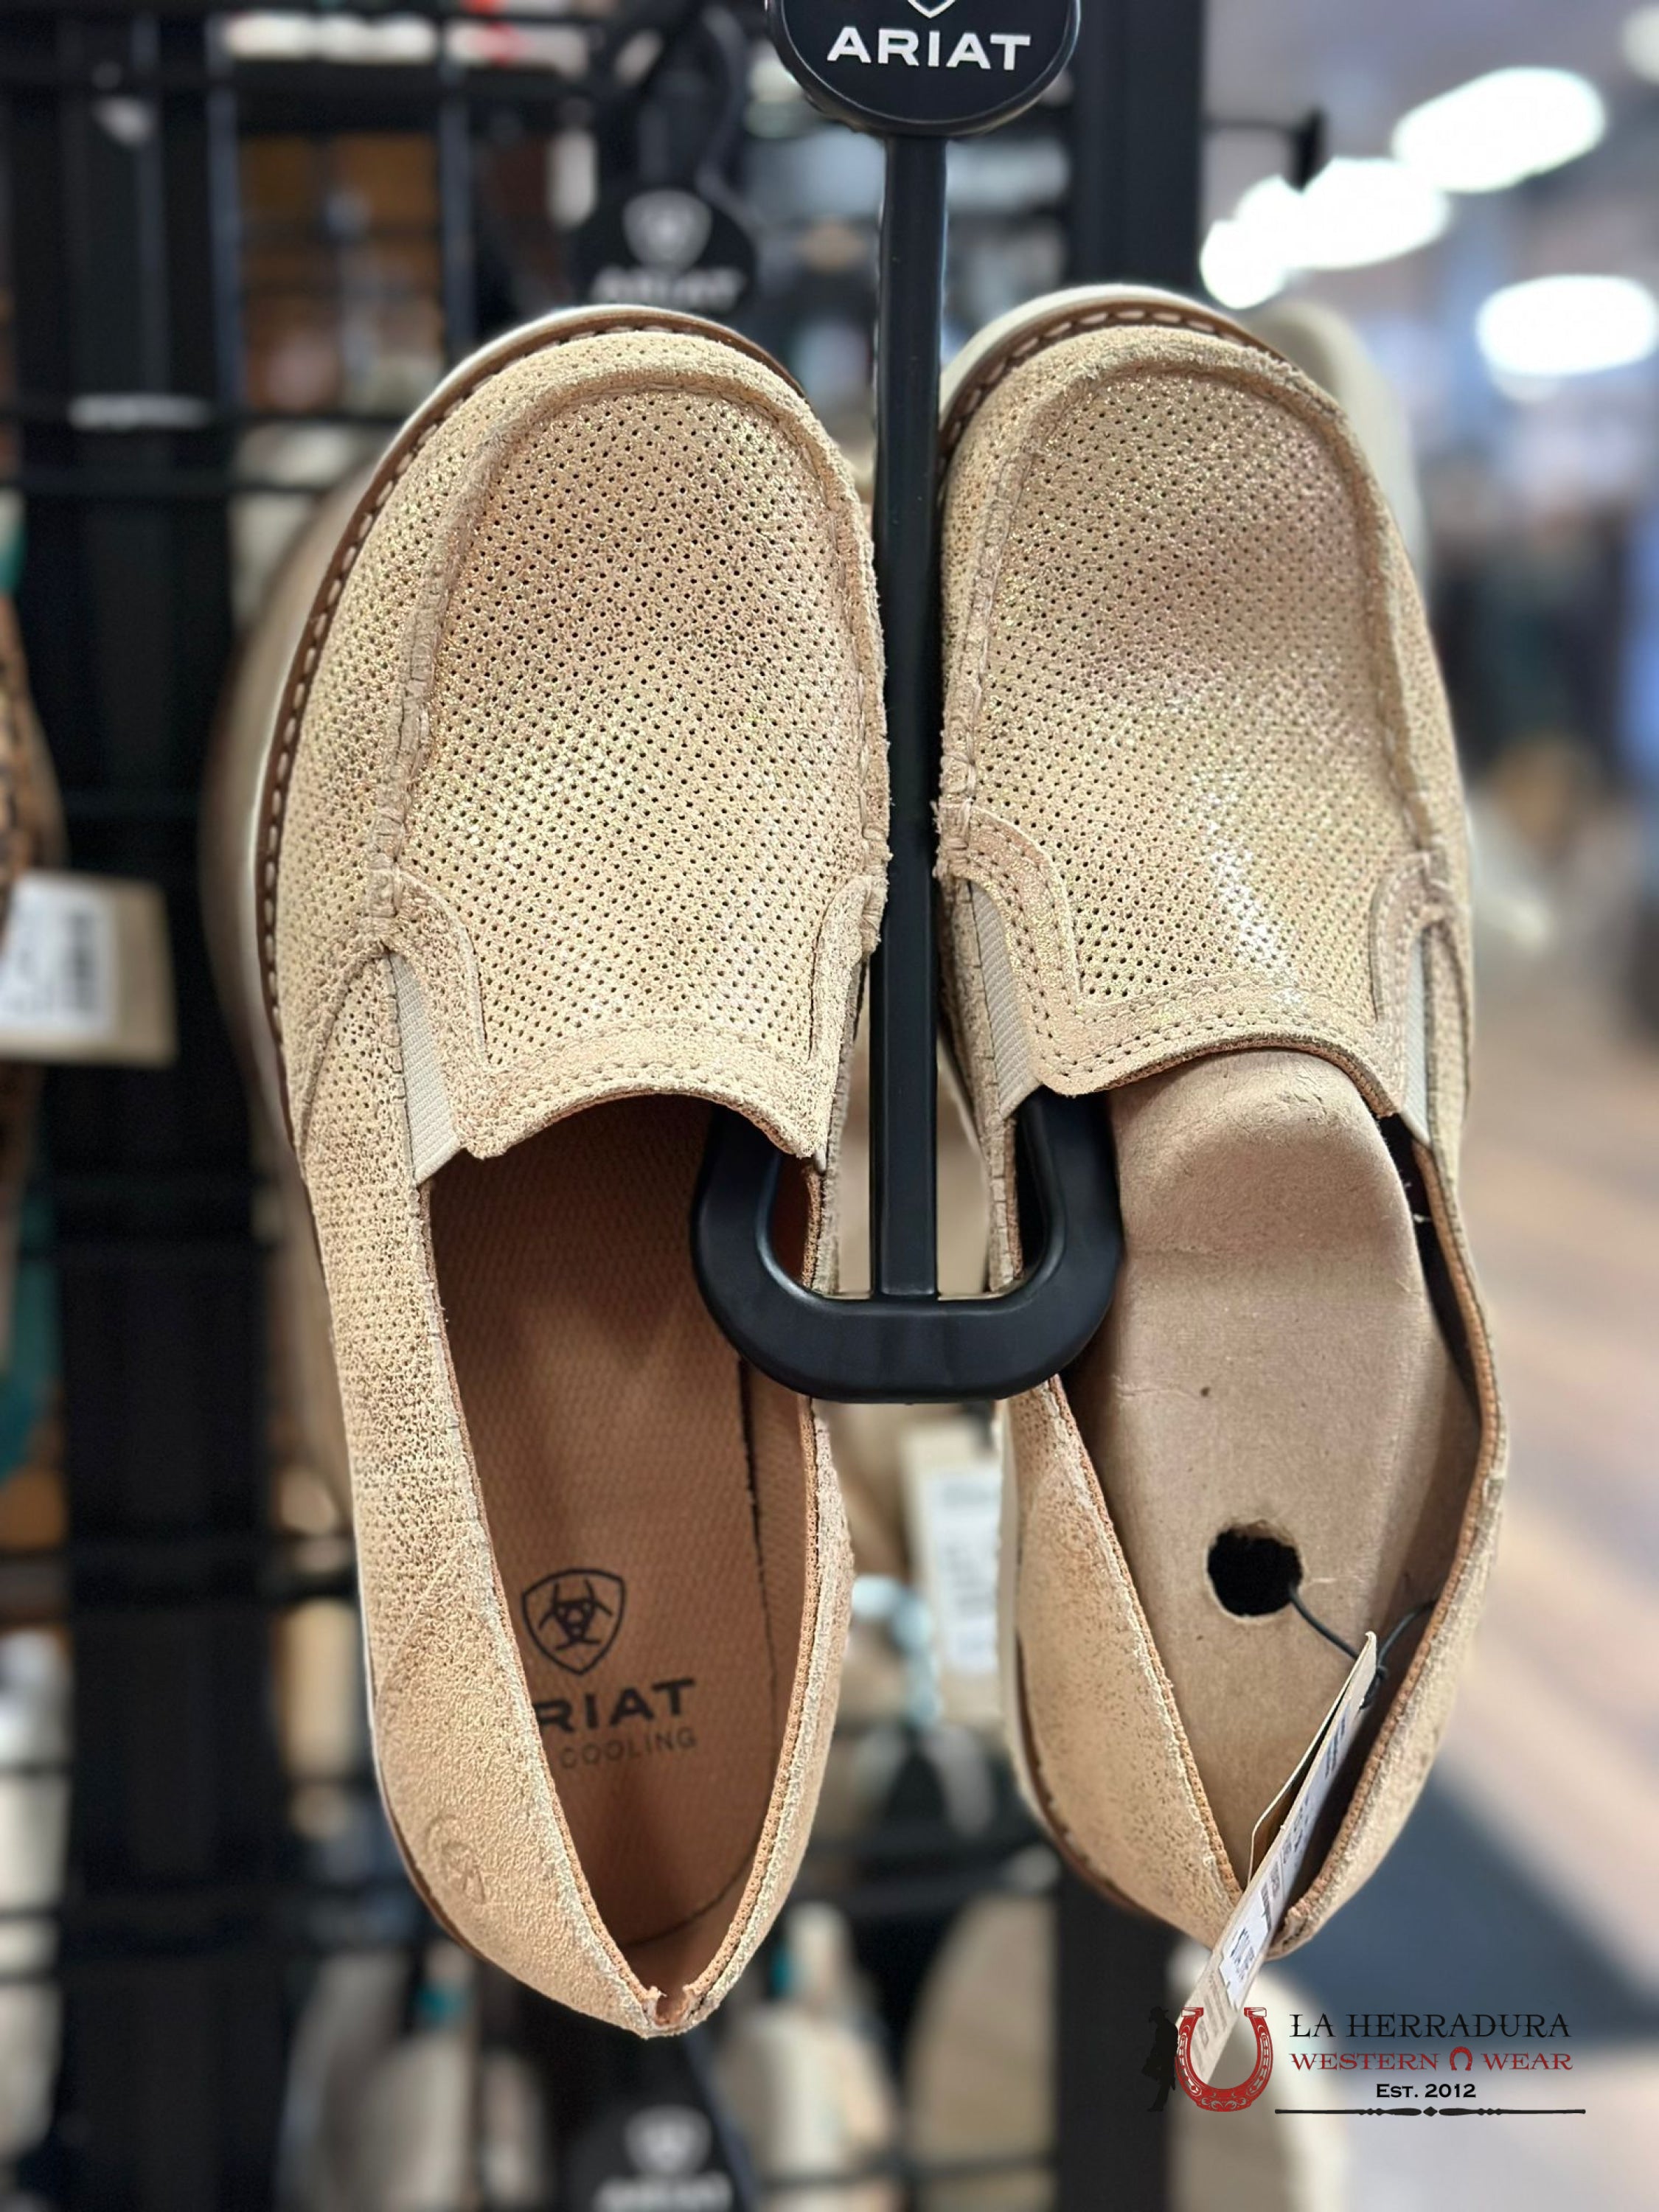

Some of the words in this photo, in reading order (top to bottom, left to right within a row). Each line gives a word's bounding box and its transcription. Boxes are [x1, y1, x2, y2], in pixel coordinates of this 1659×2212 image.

[827, 26, 1031, 70] ARIAT
[531, 1678, 695, 1733] RIAT
[561, 1726, 696, 1769] COOLING
